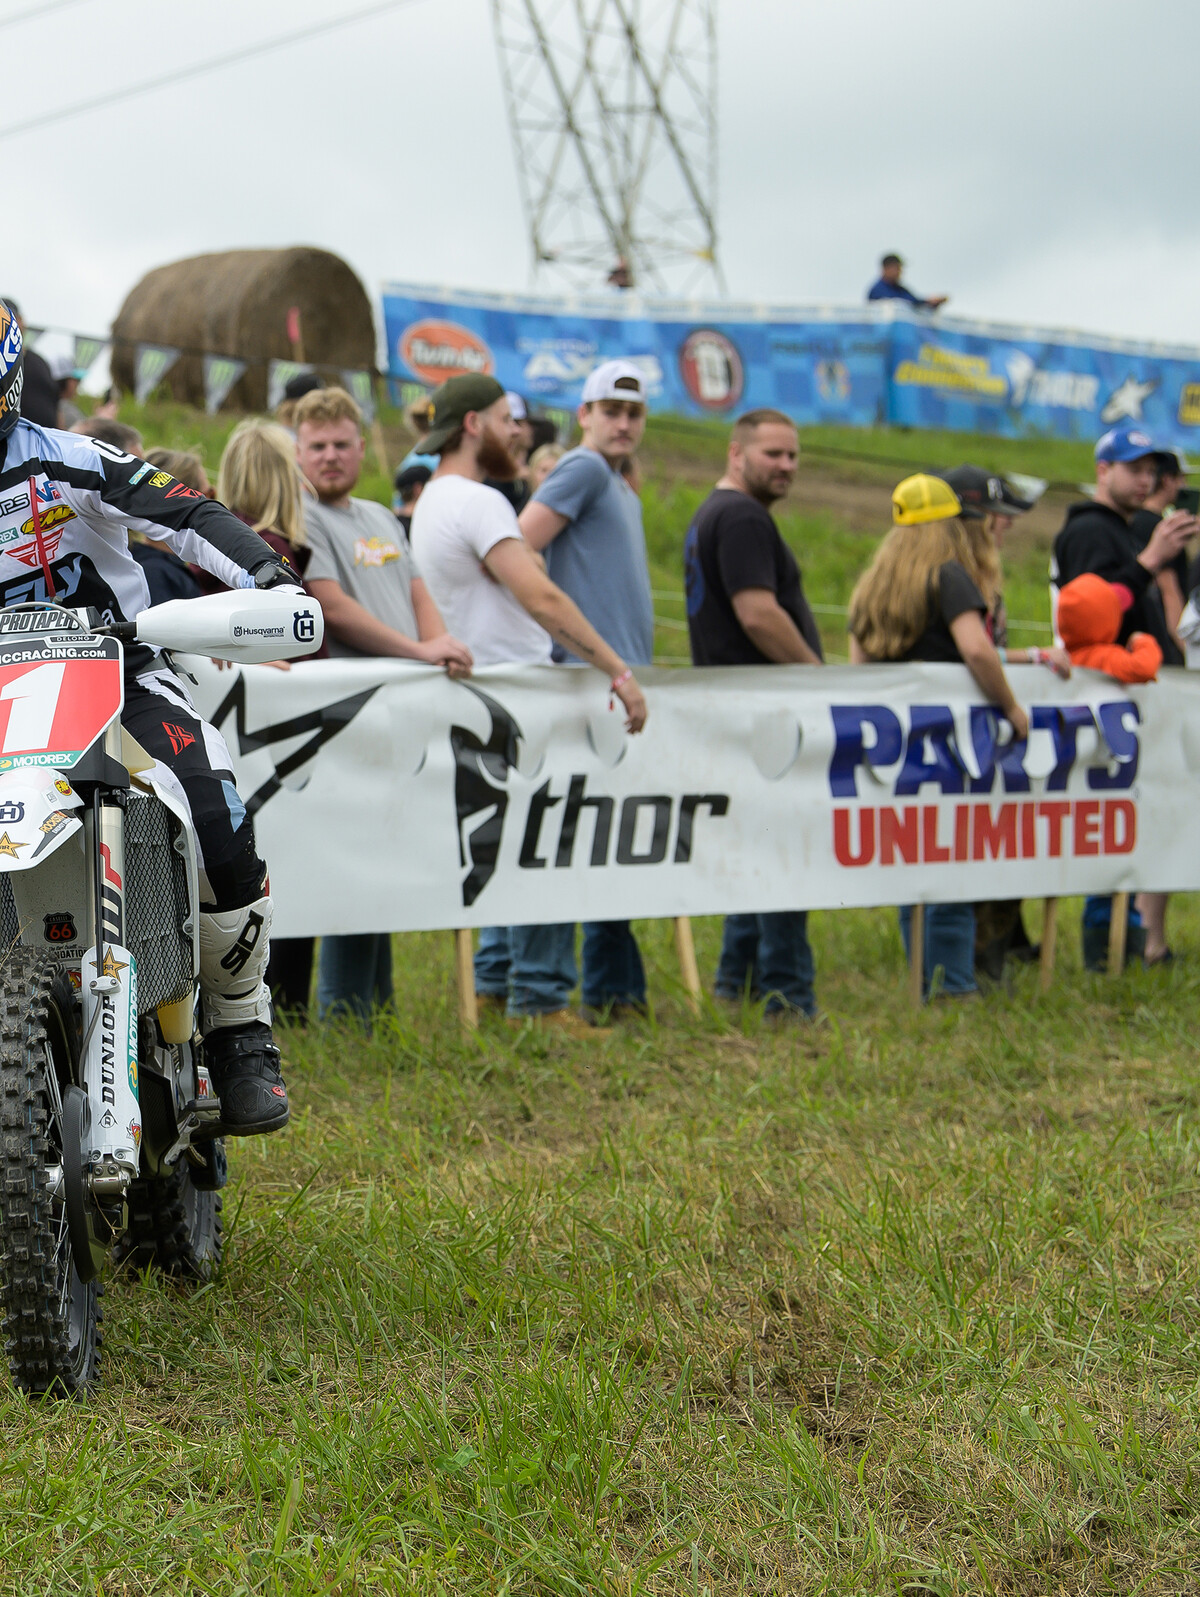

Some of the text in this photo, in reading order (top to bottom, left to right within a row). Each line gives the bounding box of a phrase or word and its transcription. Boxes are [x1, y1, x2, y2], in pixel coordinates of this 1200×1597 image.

[0, 610, 77, 633] PROTAPER
[243, 627, 284, 636] Husqvarna
[0, 662, 67, 754] 1
[13, 752, 72, 767] MOTOREX
[828, 701, 1144, 798] PARTS
[518, 774, 730, 868] thor
[832, 799, 1138, 868] UNLIMITED
[50, 923, 72, 940] 66
[102, 996, 116, 1106] DUNLOP
[128, 965, 138, 1060] MOTOREX
